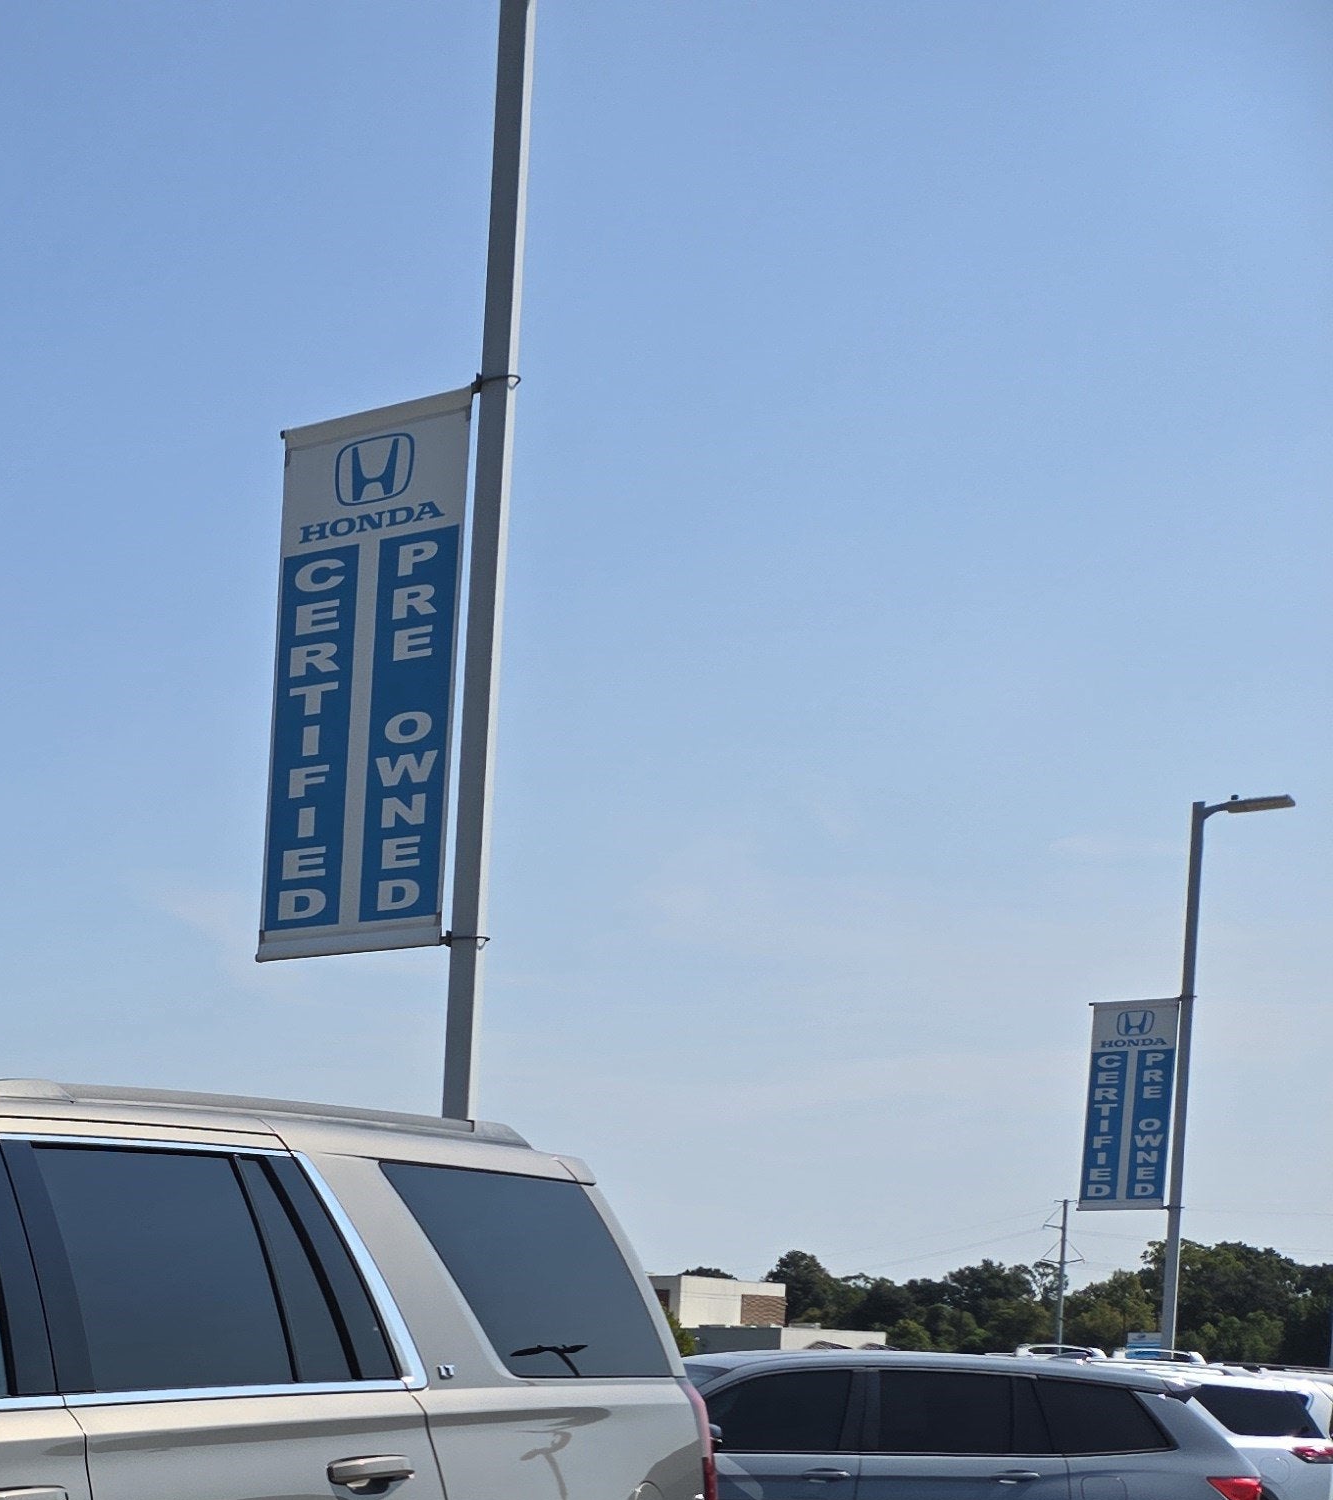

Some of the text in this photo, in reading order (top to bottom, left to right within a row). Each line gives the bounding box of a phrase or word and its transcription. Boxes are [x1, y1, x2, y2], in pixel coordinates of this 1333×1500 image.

[298, 501, 446, 544] HONDA
[277, 557, 346, 922] CERTIFIED
[375, 540, 439, 912] PRE OWNED
[1100, 1037, 1168, 1049] HONDA
[1087, 1054, 1122, 1197] CERTIFIED
[1134, 1052, 1166, 1196] PRE OWNED
